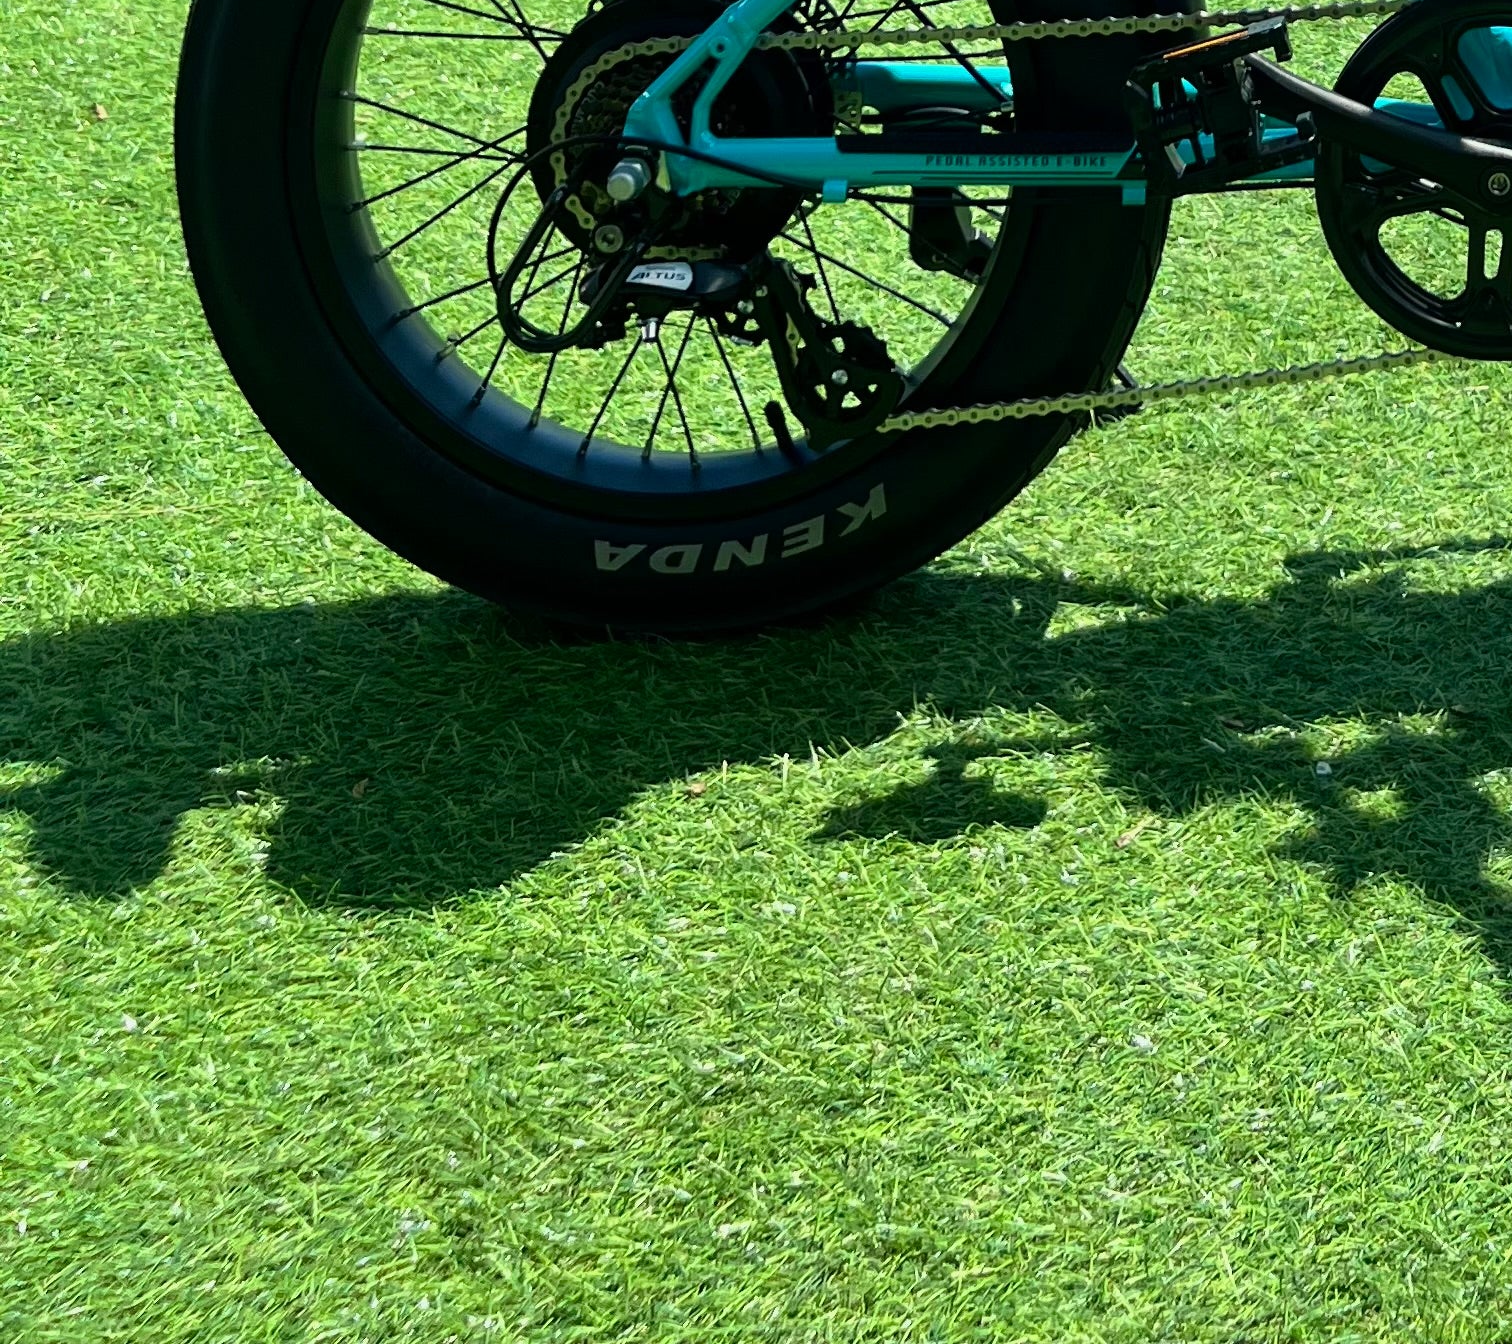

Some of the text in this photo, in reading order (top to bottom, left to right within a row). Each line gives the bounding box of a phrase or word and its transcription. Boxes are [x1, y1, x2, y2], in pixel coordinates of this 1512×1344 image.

[925, 153, 1107, 167] PEDAL ASSISTED E-BIKE
[631, 271, 686, 281] ALTUS
[594, 482, 887, 574] KENDA
